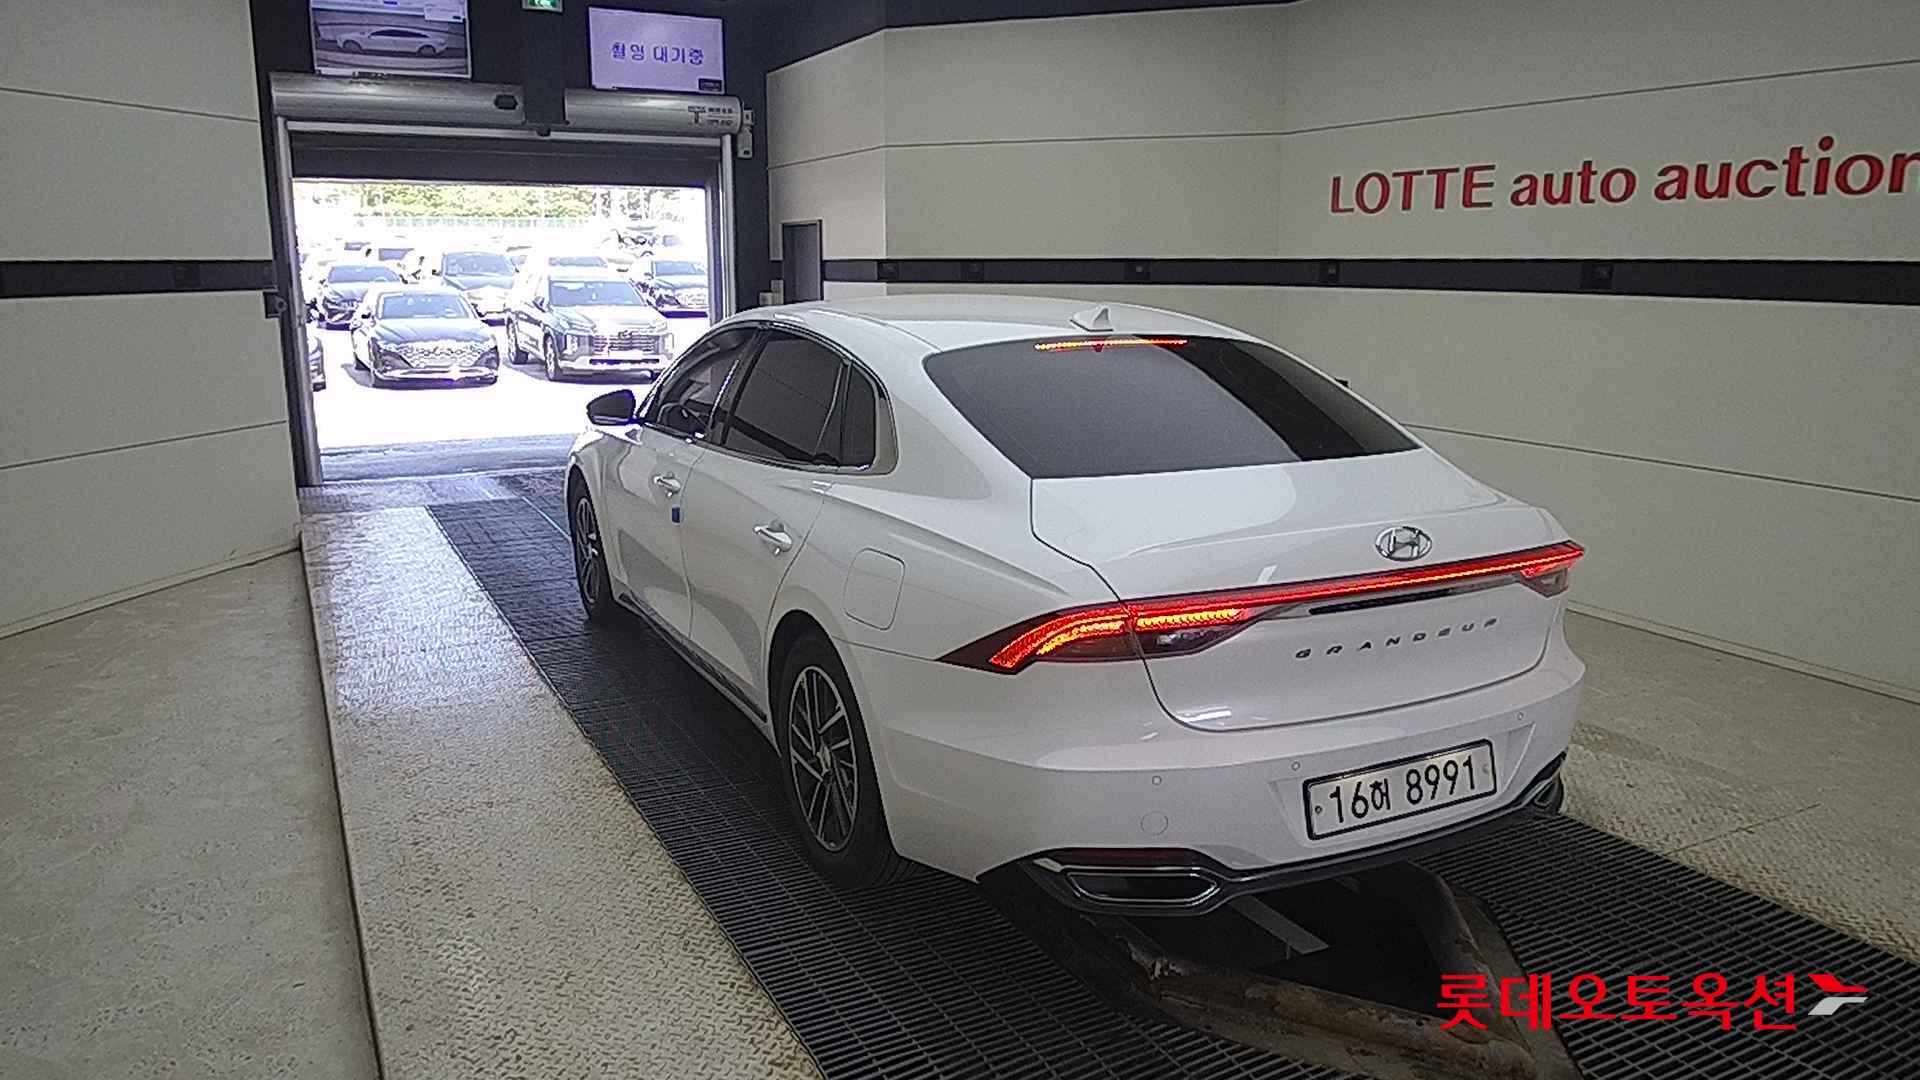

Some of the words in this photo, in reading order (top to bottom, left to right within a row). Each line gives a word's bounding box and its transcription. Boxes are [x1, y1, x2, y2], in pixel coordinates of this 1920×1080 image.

[1331, 164, 1496, 214] LOTTE
[1511, 160, 1637, 206] auto
[1295, 617, 1498, 659] GRANDEUR
[1329, 778, 1391, 824] 16허
[1406, 755, 1475, 805] 8991
